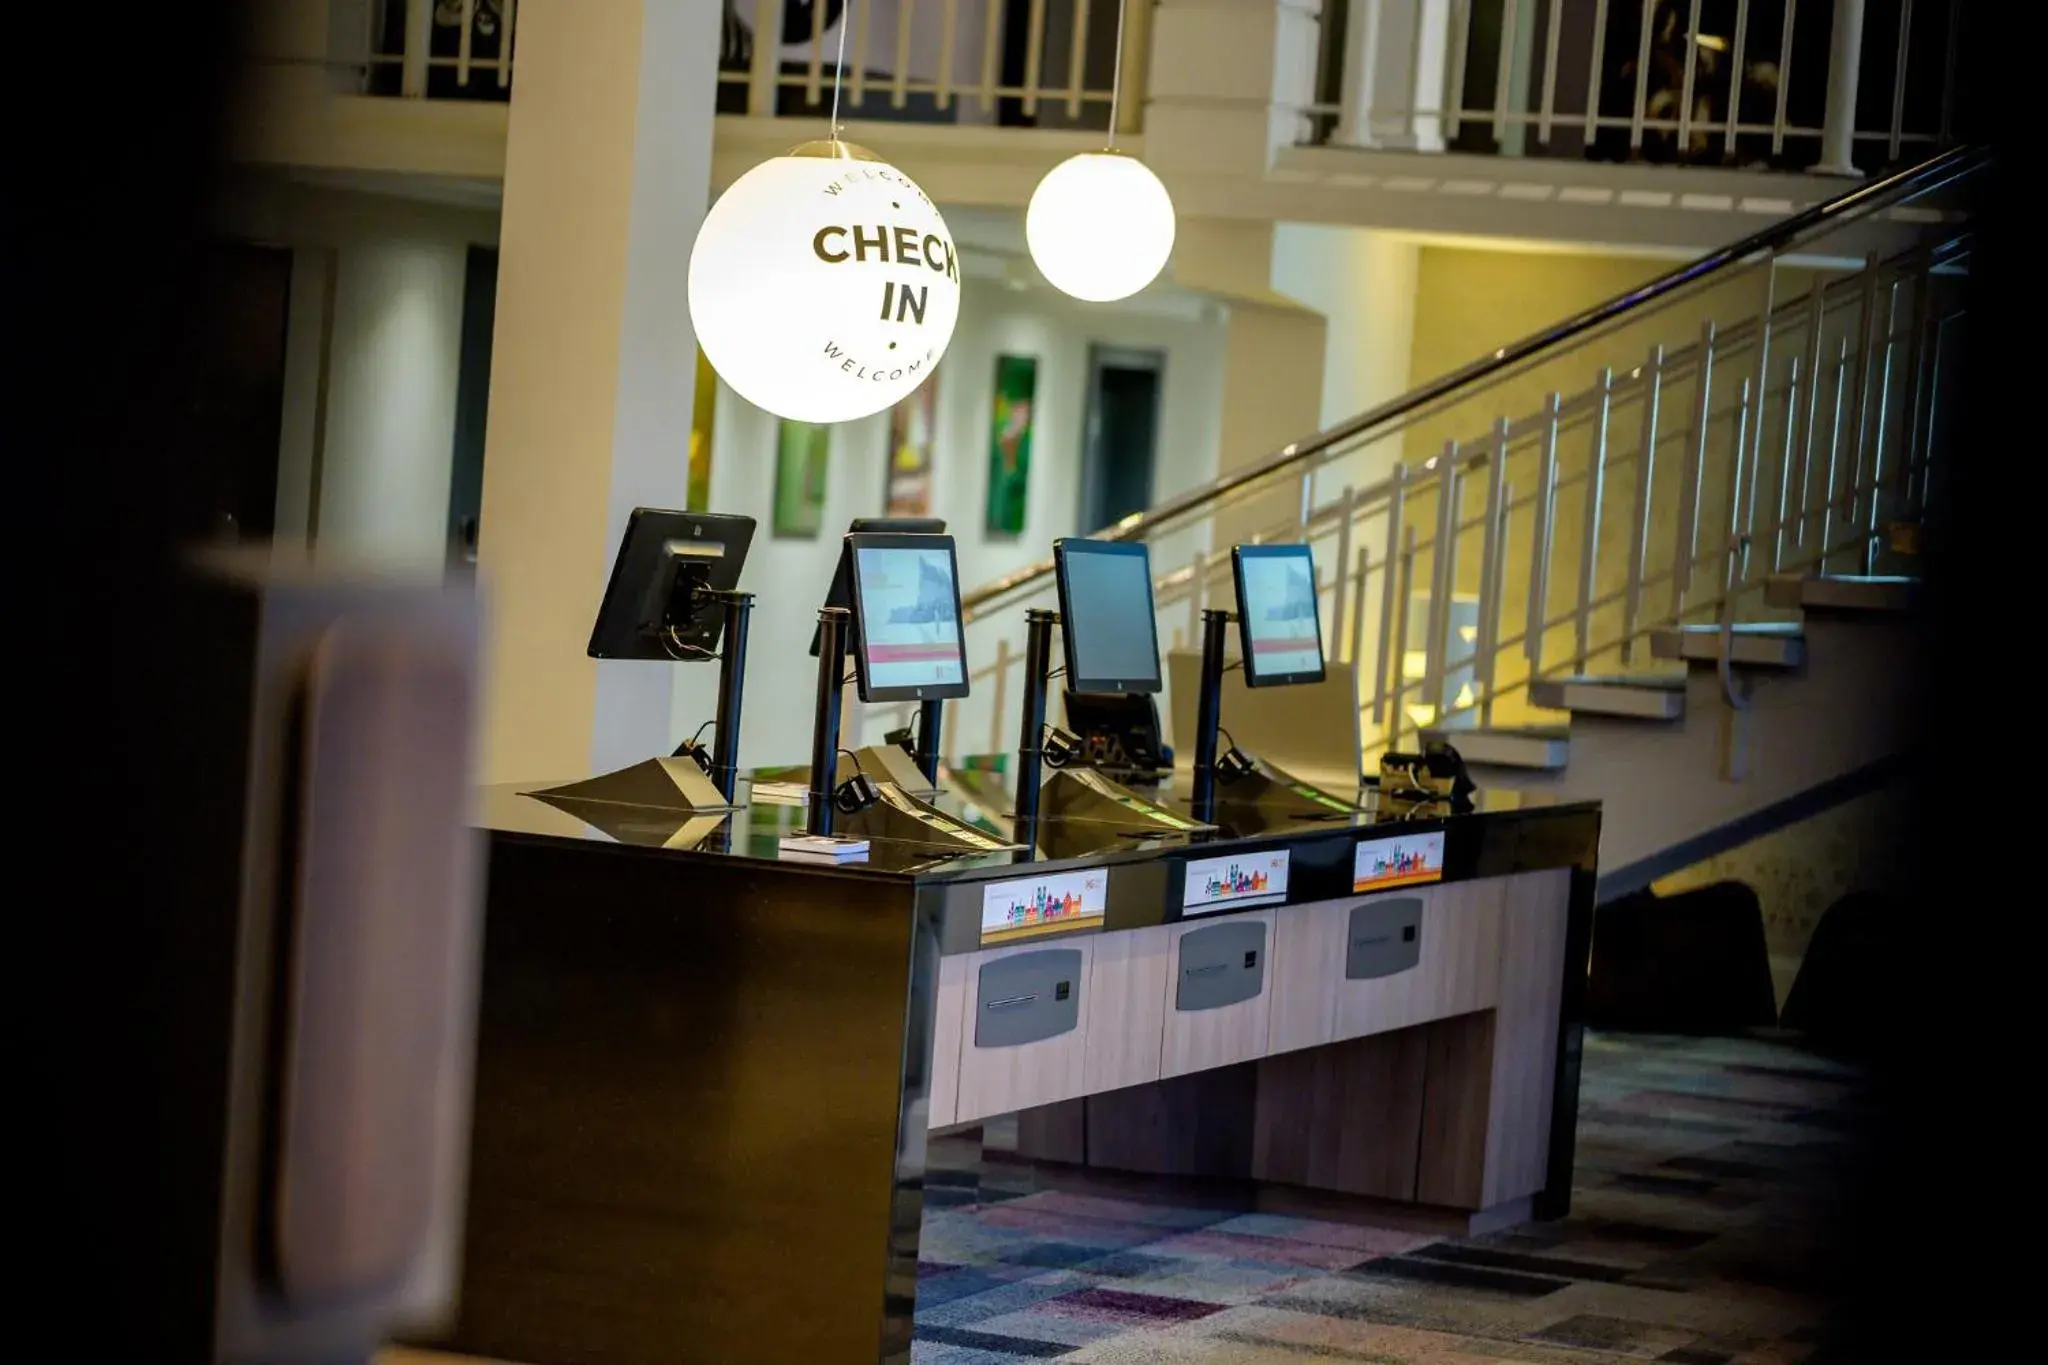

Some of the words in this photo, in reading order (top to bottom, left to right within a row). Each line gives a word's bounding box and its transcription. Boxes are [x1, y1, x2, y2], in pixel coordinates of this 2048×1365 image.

[824, 166, 938, 216] WELCO
[813, 225, 958, 284] CHECK
[880, 281, 928, 325] IN
